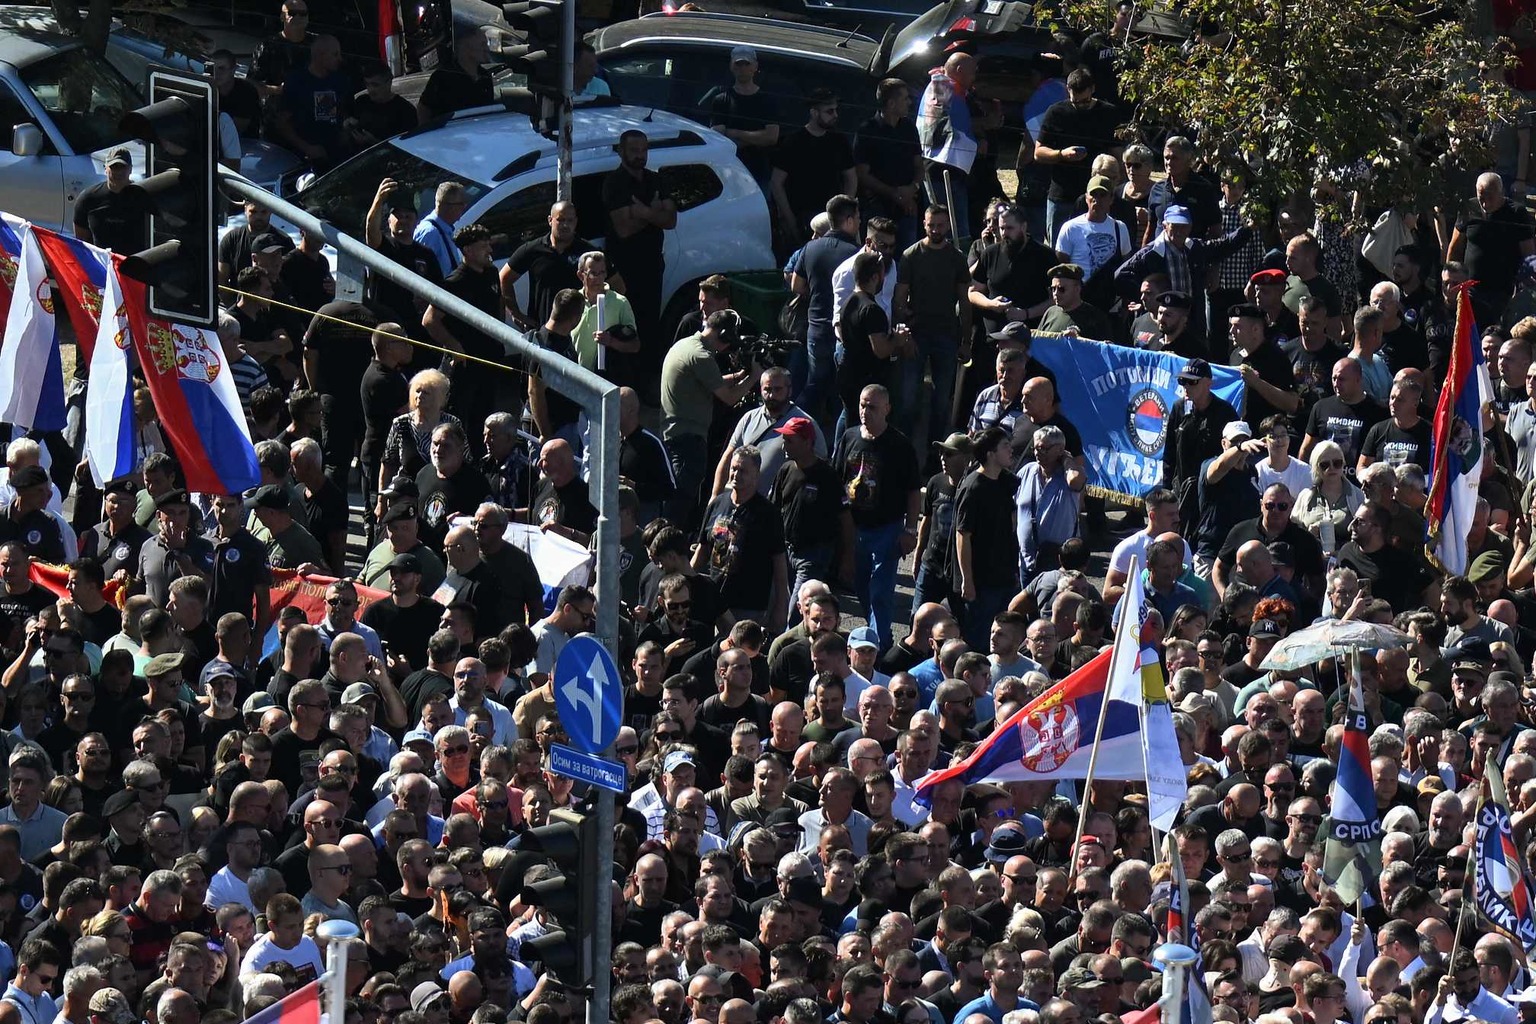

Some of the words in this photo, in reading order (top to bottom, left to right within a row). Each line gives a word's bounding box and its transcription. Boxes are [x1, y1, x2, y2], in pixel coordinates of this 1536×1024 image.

[1327, 416, 1363, 427] ЖИВИШ
[1384, 442, 1418, 452] ЖИВИШ
[553, 752, 571, 769] Осим
[572, 760, 581, 771] за
[581, 764, 623, 785] ватрогасце
